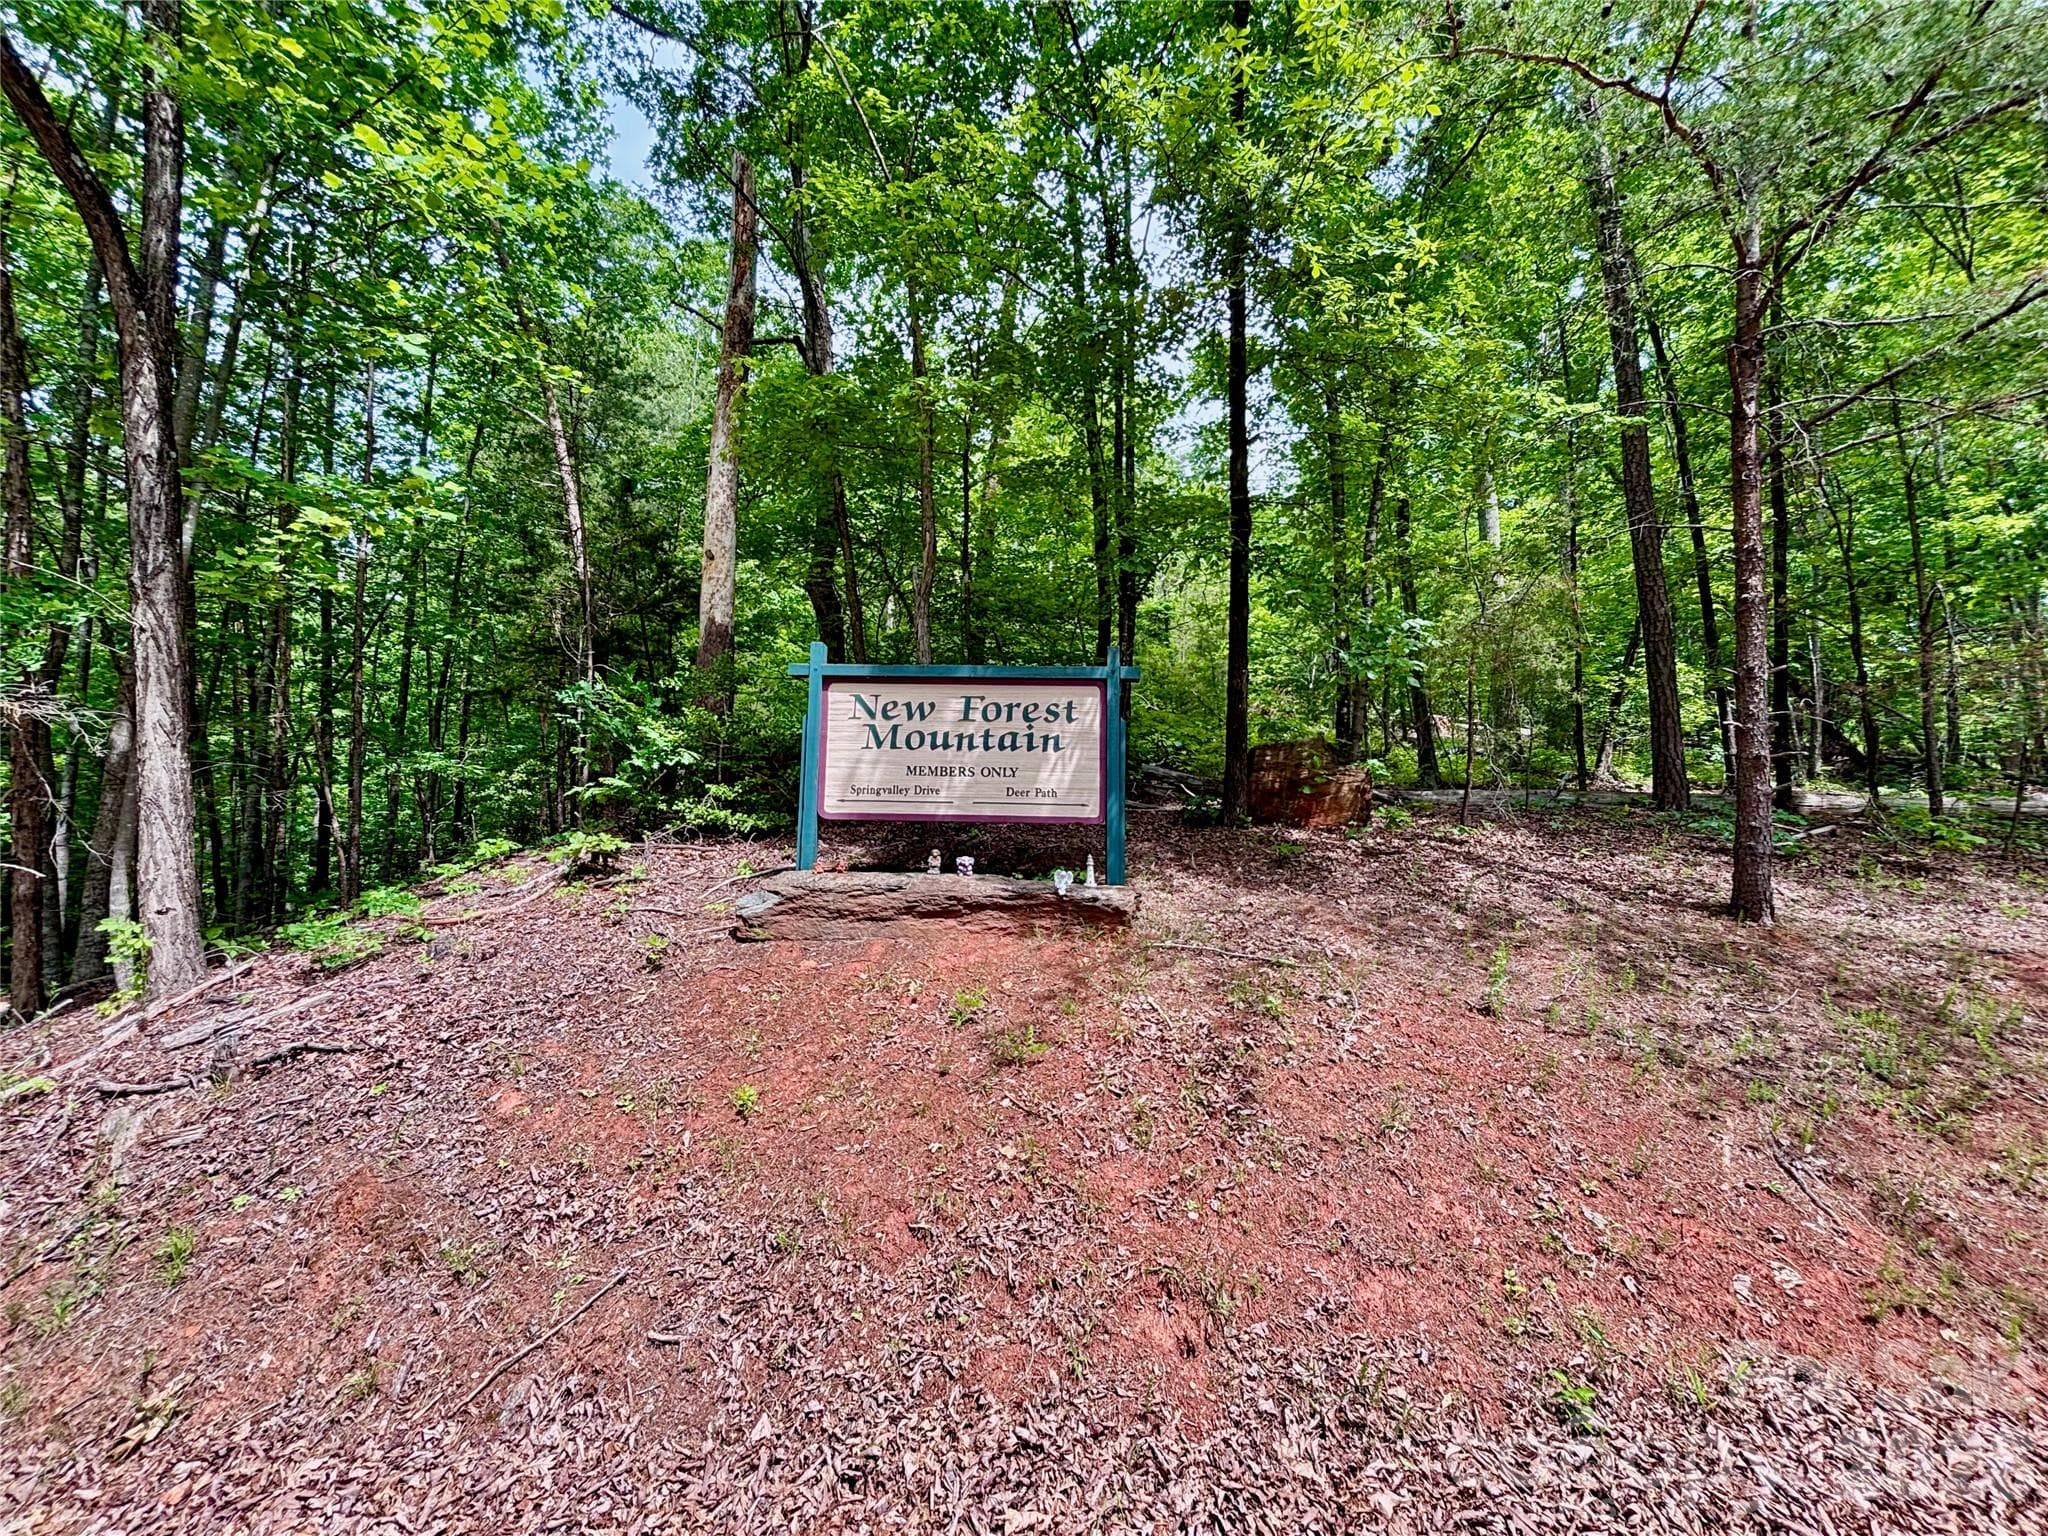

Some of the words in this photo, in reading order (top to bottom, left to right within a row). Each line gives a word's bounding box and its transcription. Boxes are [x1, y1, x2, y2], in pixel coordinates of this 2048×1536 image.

[848, 693, 936, 720] New
[958, 695, 1079, 724] Forest
[861, 722, 1065, 752] Mountain
[905, 765, 975, 778] MEMBERS
[980, 766, 1019, 778] ONLY
[850, 784, 910, 796] Springvalley
[913, 785, 940, 796] Drive
[1005, 787, 1030, 798] Deer
[1034, 787, 1058, 798] Path
